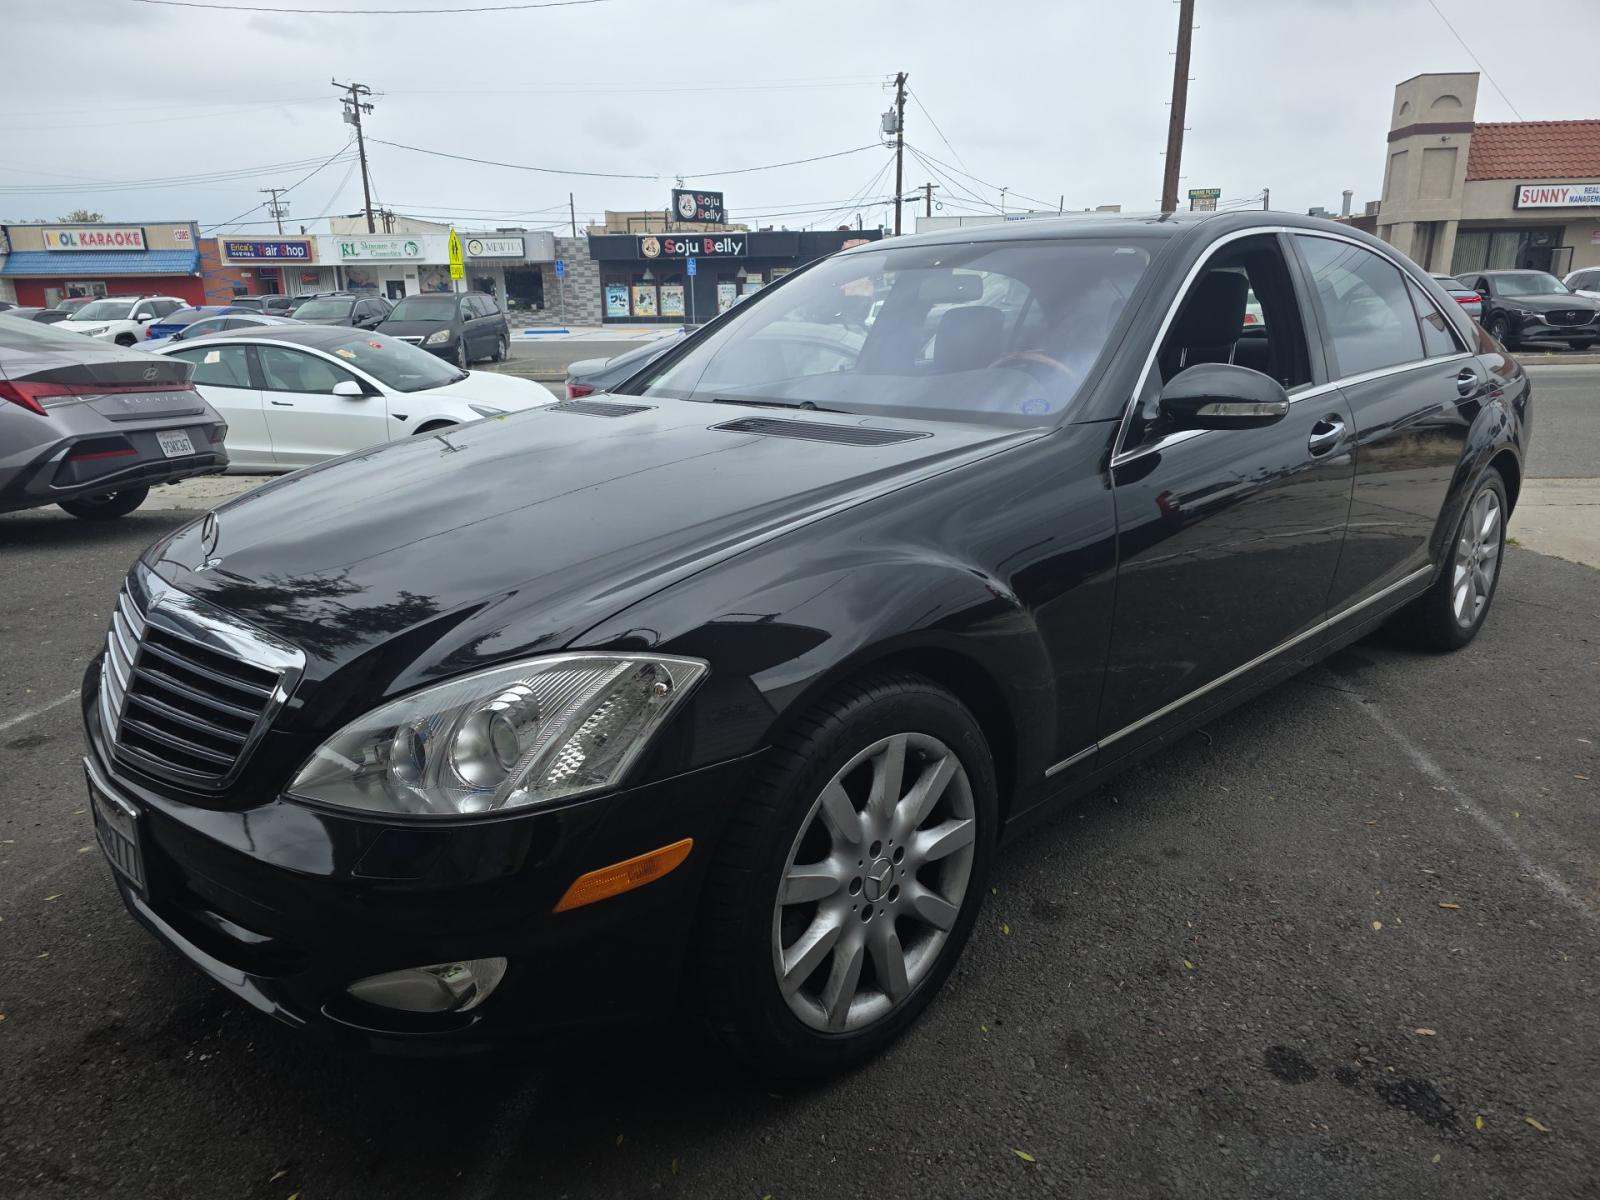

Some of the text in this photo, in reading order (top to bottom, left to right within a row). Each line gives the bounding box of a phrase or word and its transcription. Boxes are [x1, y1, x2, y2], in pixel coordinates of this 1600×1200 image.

[697, 194, 720, 208] Soju
[1522, 189, 1570, 203] SUNNY
[697, 208, 722, 222] Belly
[79, 232, 142, 246] KARAOKE
[231, 243, 254, 251] Erica's
[258, 244, 277, 256] Hair
[281, 244, 304, 258] Shop
[664, 238, 743, 257] Soju Belly
